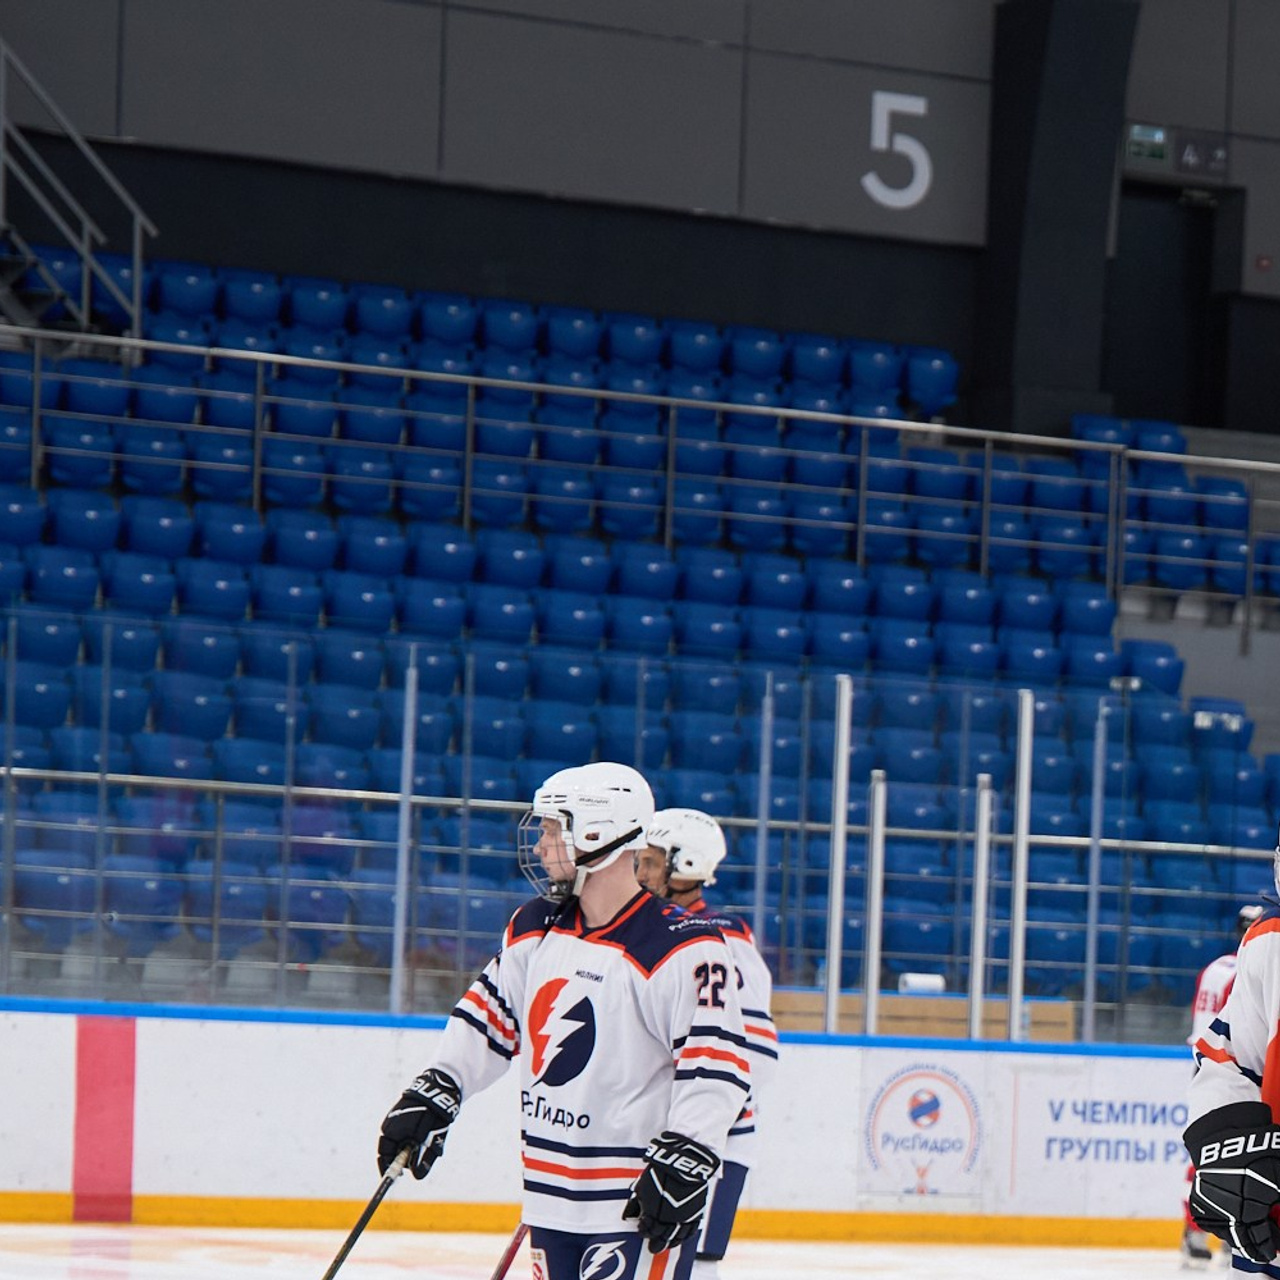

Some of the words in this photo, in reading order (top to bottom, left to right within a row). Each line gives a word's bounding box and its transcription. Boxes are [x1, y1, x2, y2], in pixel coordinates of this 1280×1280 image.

[861, 91, 933, 208] 5
[692, 961, 727, 1009] 22
[410, 1078, 461, 1119] AUER
[1049, 1100, 1064, 1122] V
[645, 1143, 714, 1180] AUER
[881, 1132, 963, 1155] РусГидро
[1045, 1138, 1155, 1162] ГРУППЫ
